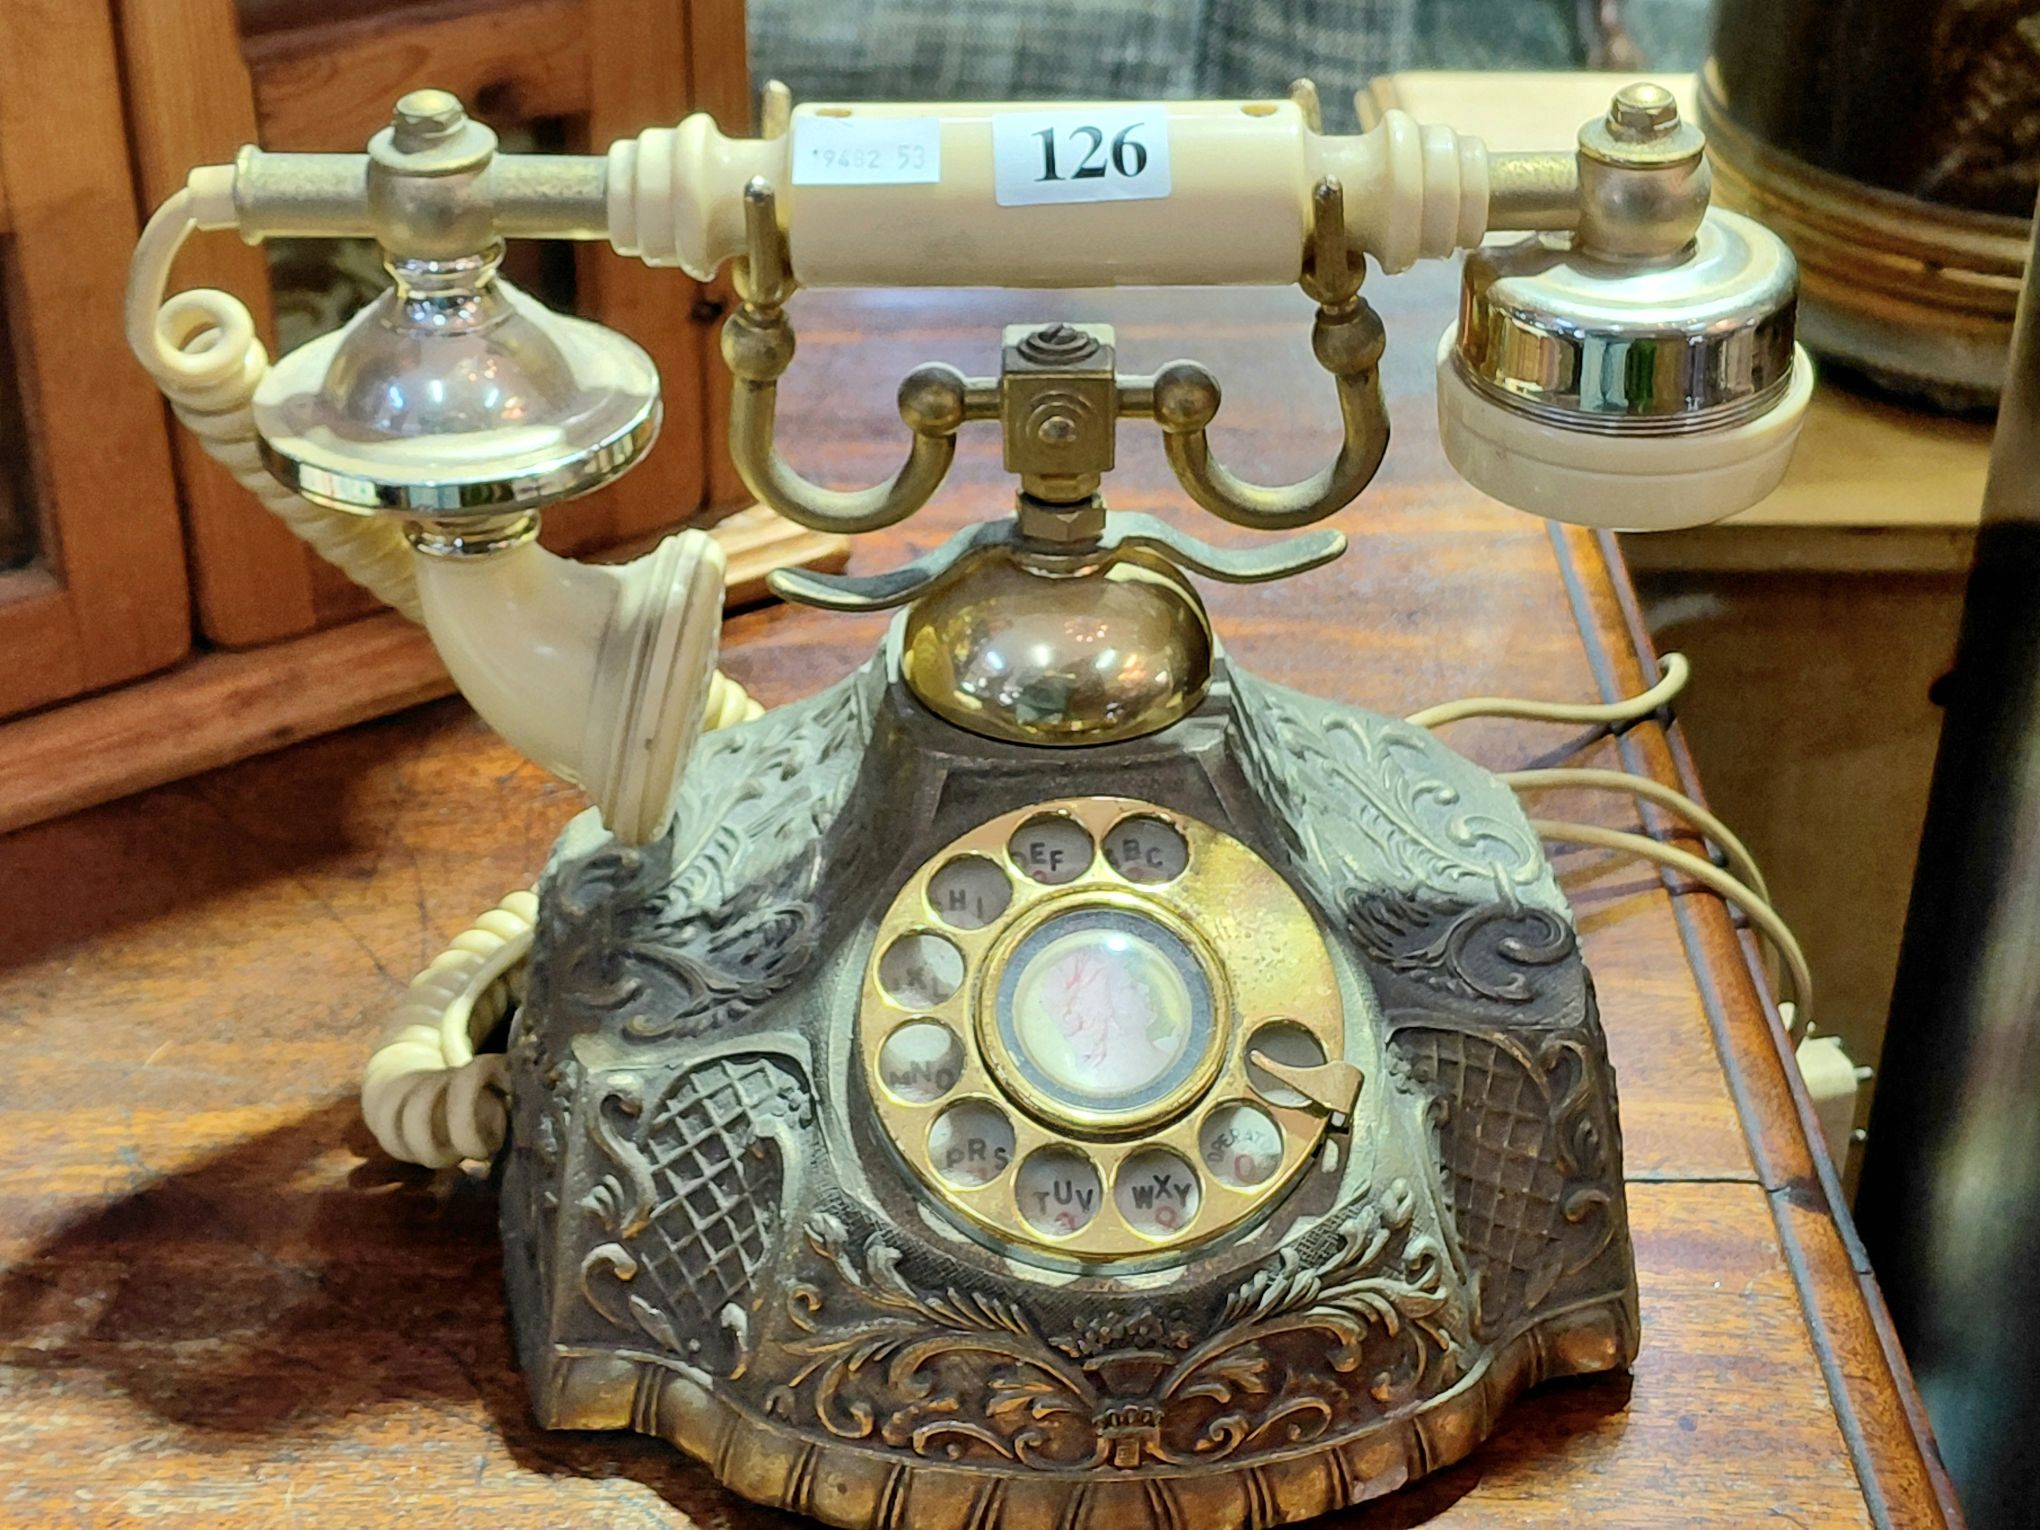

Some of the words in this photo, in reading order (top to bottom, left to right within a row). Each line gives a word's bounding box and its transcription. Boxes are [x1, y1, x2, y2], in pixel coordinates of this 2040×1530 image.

[1031, 122, 1148, 182] 126
[946, 1137, 1010, 1171] PRS
[1032, 1179, 1094, 1215] TUV
[1131, 1173, 1192, 1210] WXY
